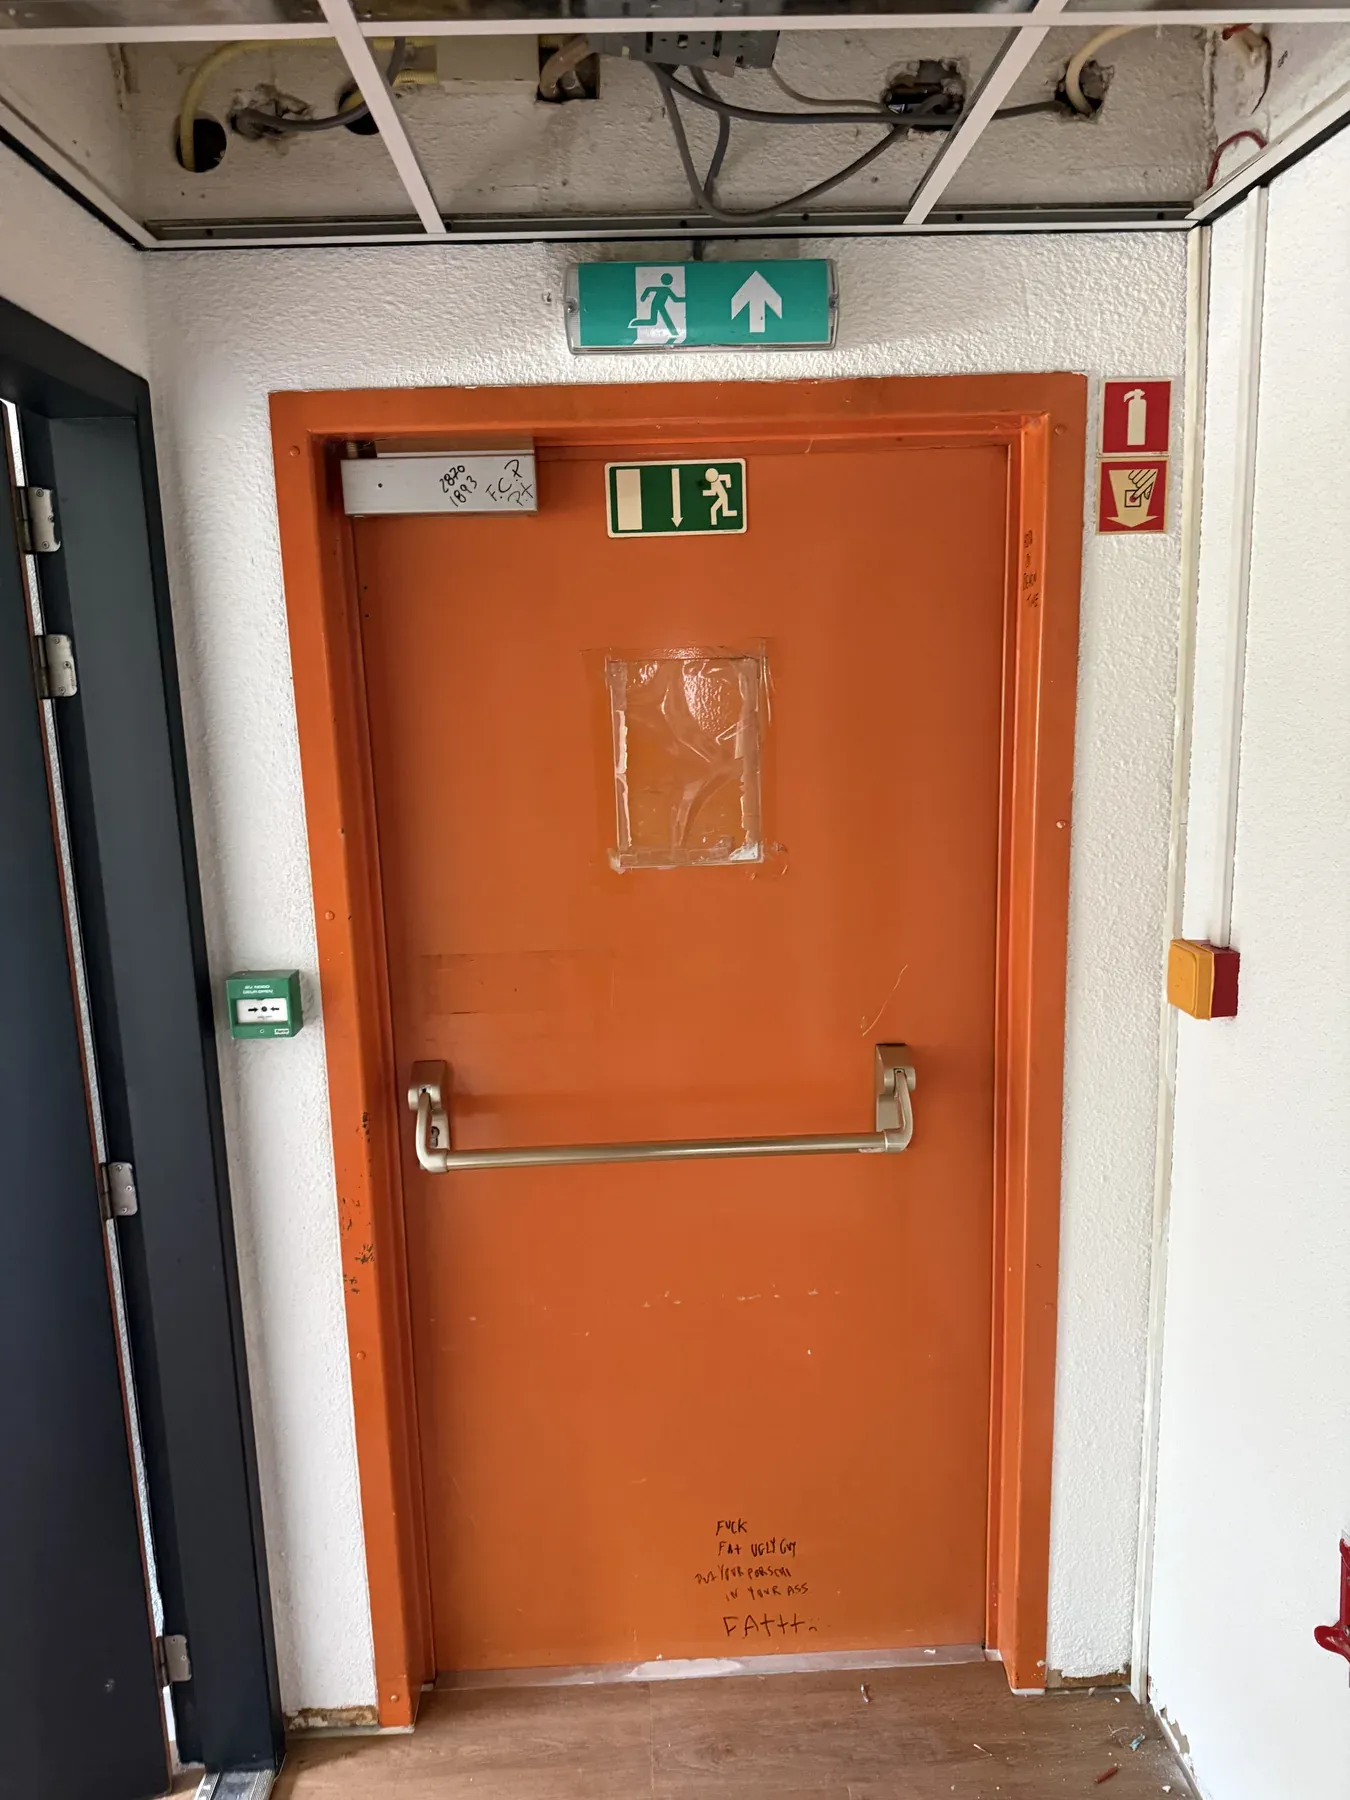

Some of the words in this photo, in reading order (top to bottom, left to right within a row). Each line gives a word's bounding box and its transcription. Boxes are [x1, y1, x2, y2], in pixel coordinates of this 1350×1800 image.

[439, 465, 465, 493] 2870
[450, 475, 478, 507] 1893
[751, 1537, 776, 1557] UGLY
[780, 1538, 796, 1558] GUY
[747, 1586, 781, 1600] YOUR
[788, 1582, 809, 1596] ASS
